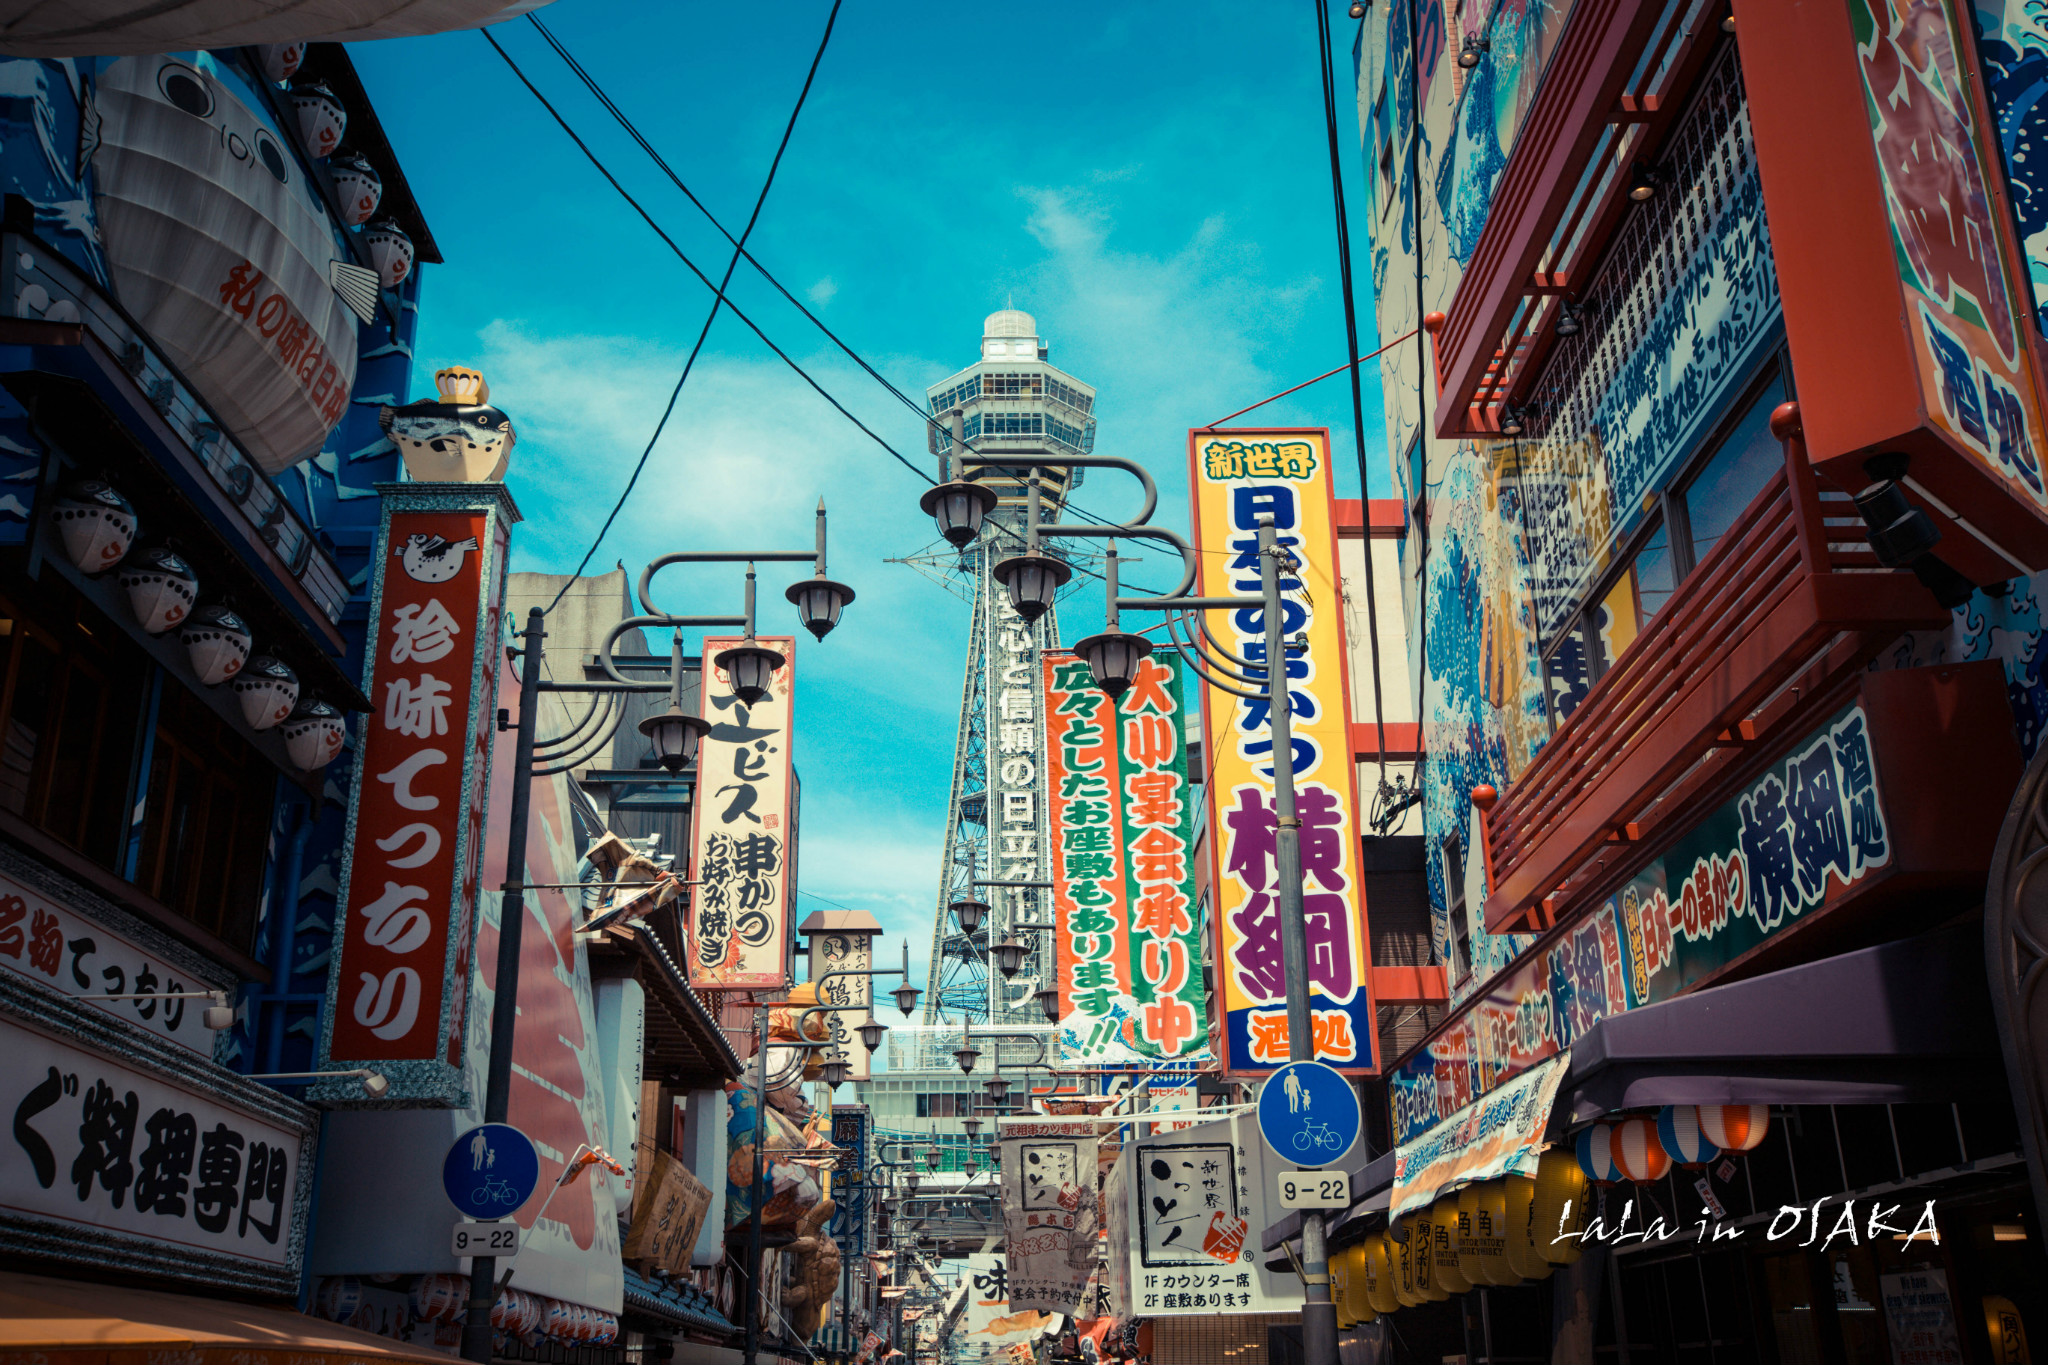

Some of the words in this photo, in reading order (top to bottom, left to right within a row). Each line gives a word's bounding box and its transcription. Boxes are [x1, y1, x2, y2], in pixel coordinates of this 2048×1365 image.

[1693, 247, 1721, 387] たこ
[1704, 229, 1734, 370] いか
[1726, 189, 1759, 338] ホルモン
[220, 260, 347, 426] 私の味は日本
[1682, 264, 1710, 402] サーモン
[1206, 443, 1316, 478] 新世界
[1230, 486, 1316, 777] 日本一の串かつ
[354, 598, 462, 1042] 珍味てっちり
[998, 583, 1038, 1009] 心と信頼の日立グルプ
[1740, 740, 1850, 926] 横綱
[1838, 716, 1885, 870] 酒処
[700, 834, 730, 964] お好み焼き
[735, 833, 776, 943] 串かつ
[1227, 786, 1351, 1000] 横綱
[1641, 855, 1744, 972] 日本一の串かつ
[1624, 889, 1647, 999] 新世界
[1252, 1014, 1349, 1058] 酒処
[834, 1117, 860, 1170] 麻雀
[1006, 1124, 1093, 1137] 元祖串カツ専門店
[1149, 1087, 1189, 1097] サヒビール
[13, 1066, 288, 1244] ぐ料理専門
[1151, 1159, 1201, 1253] いっとく
[1201, 1160, 1225, 1208] 新世界
[1237, 1147, 1250, 1216] 商標登録
[1417, 1222, 1431, 1287] 角ハイボール
[1435, 1224, 1449, 1250] 角
[1459, 1211, 1471, 1237] 角
[1479, 1211, 1491, 1237] 角
[974, 1260, 1008, 1302] 味
[1163, 1274, 1250, 1288] カウンター席
[1164, 1293, 1251, 1308] 座敷あります
